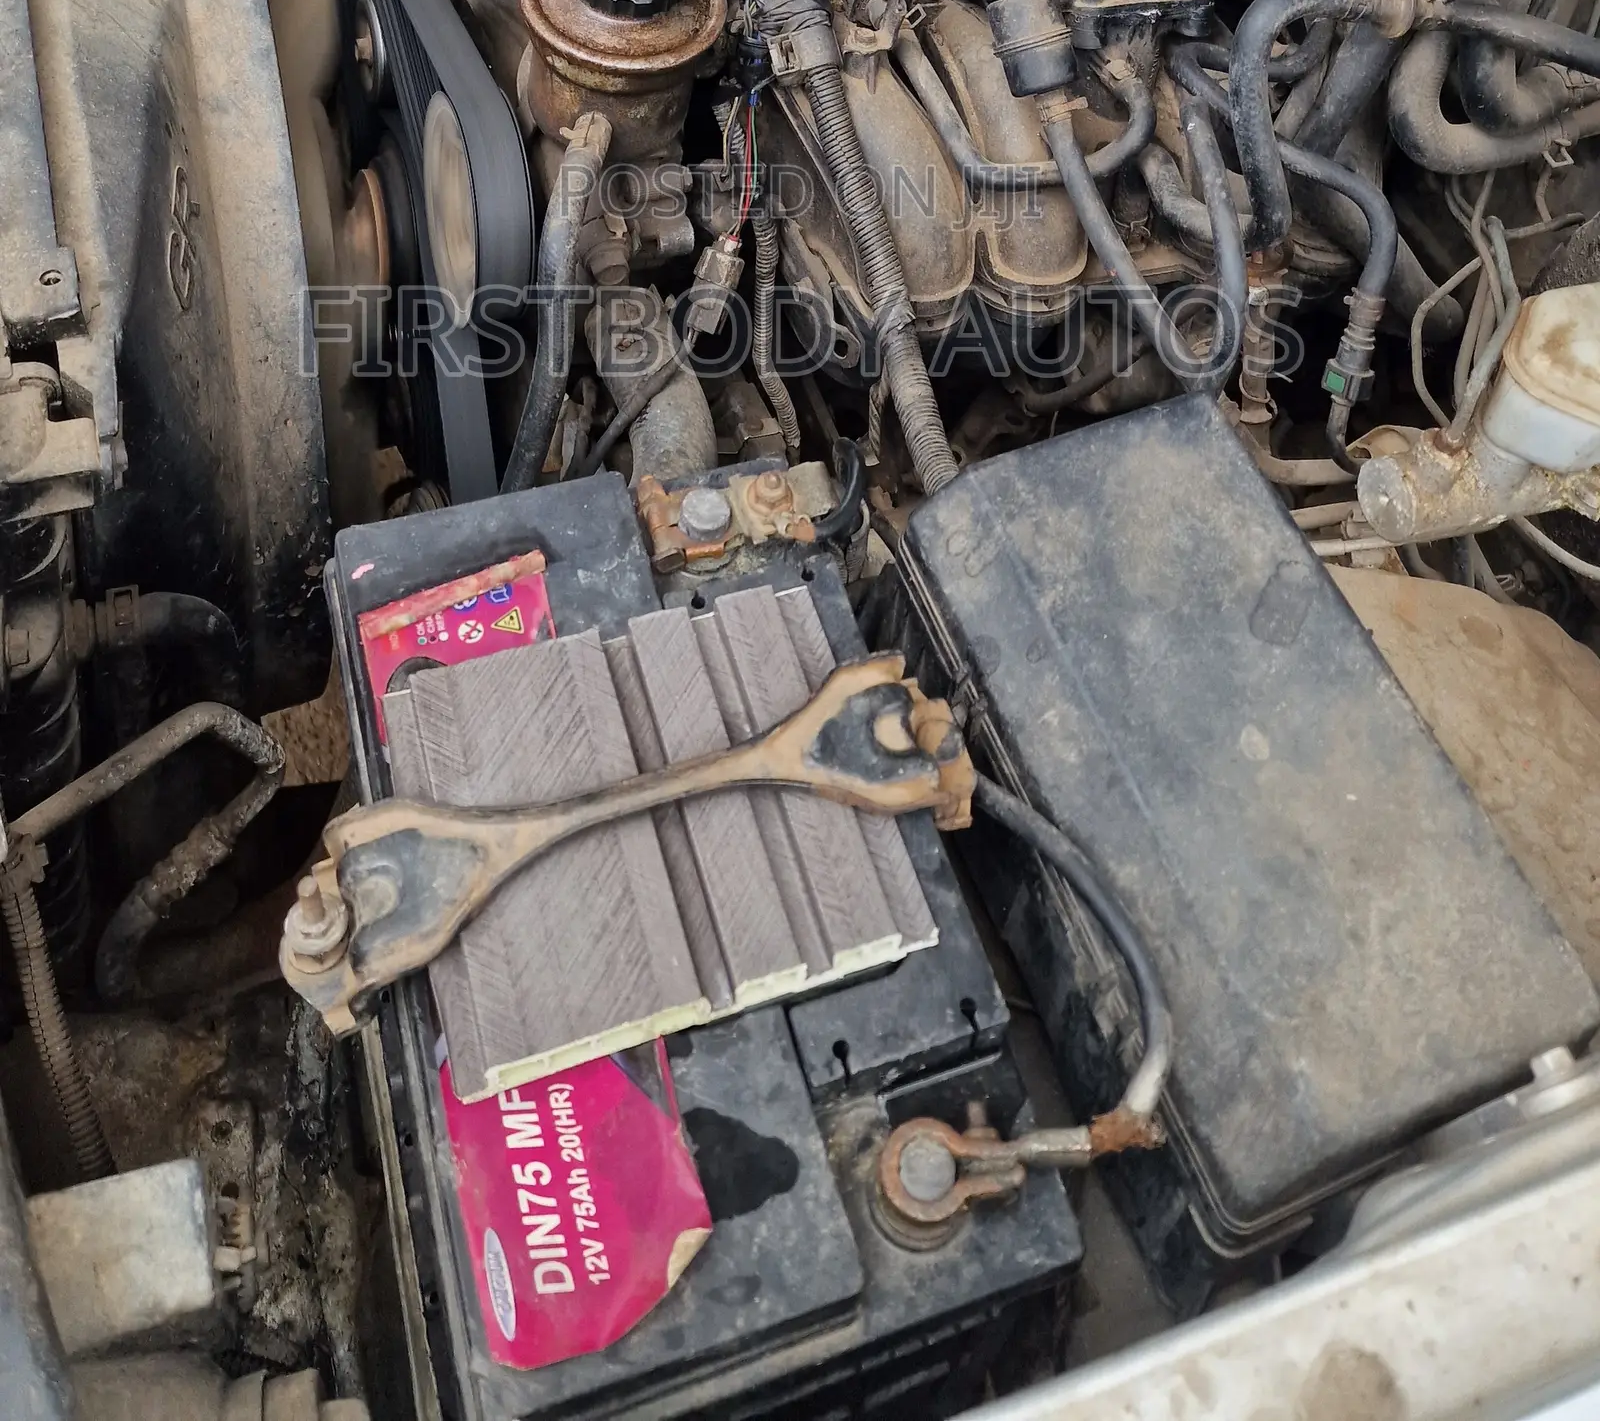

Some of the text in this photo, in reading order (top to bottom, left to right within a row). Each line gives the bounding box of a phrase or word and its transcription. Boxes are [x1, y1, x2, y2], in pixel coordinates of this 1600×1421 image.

[416, 621, 425, 635] OK
[498, 1088, 575, 1294] DIN75 MF
[547, 1083, 611, 1285] 12V 75Ah 20(HR)
